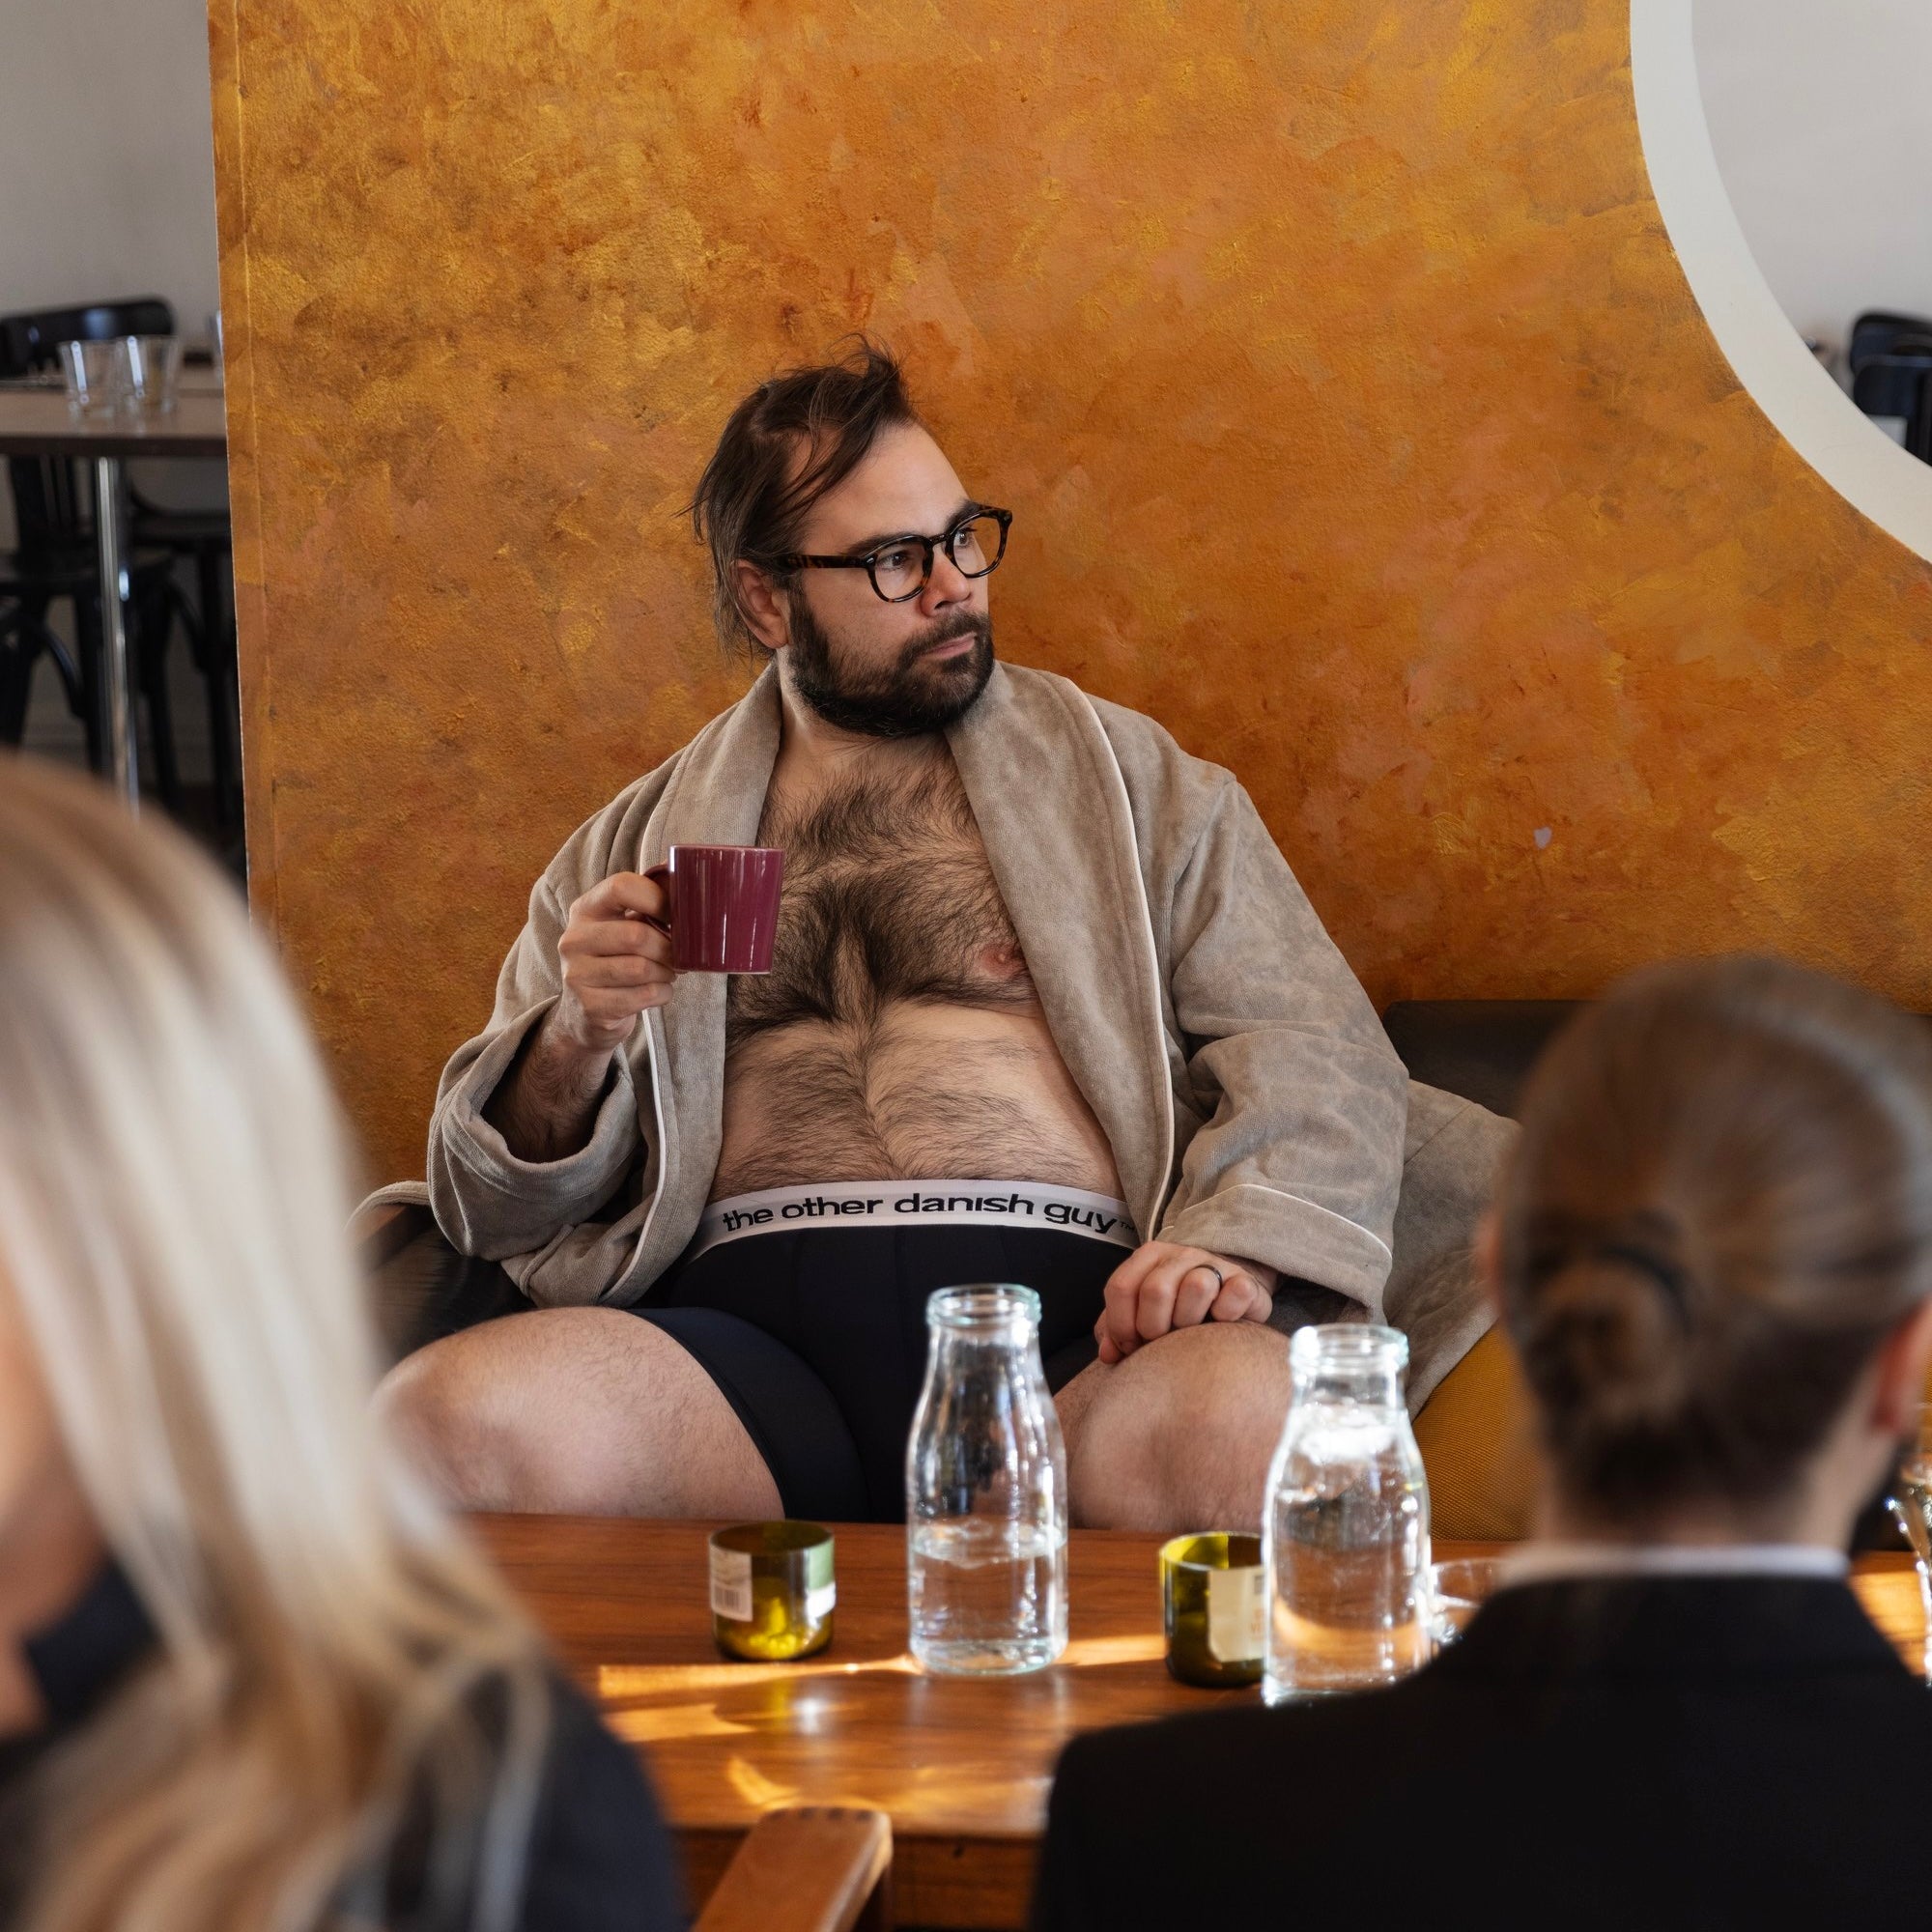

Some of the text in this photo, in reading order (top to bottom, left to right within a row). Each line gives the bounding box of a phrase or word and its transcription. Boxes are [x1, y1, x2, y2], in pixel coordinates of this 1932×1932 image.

[723, 1208, 774, 1232] the
[781, 1197, 883, 1218] other
[894, 1193, 1035, 1215] danish
[1043, 1203, 1118, 1234] guy
